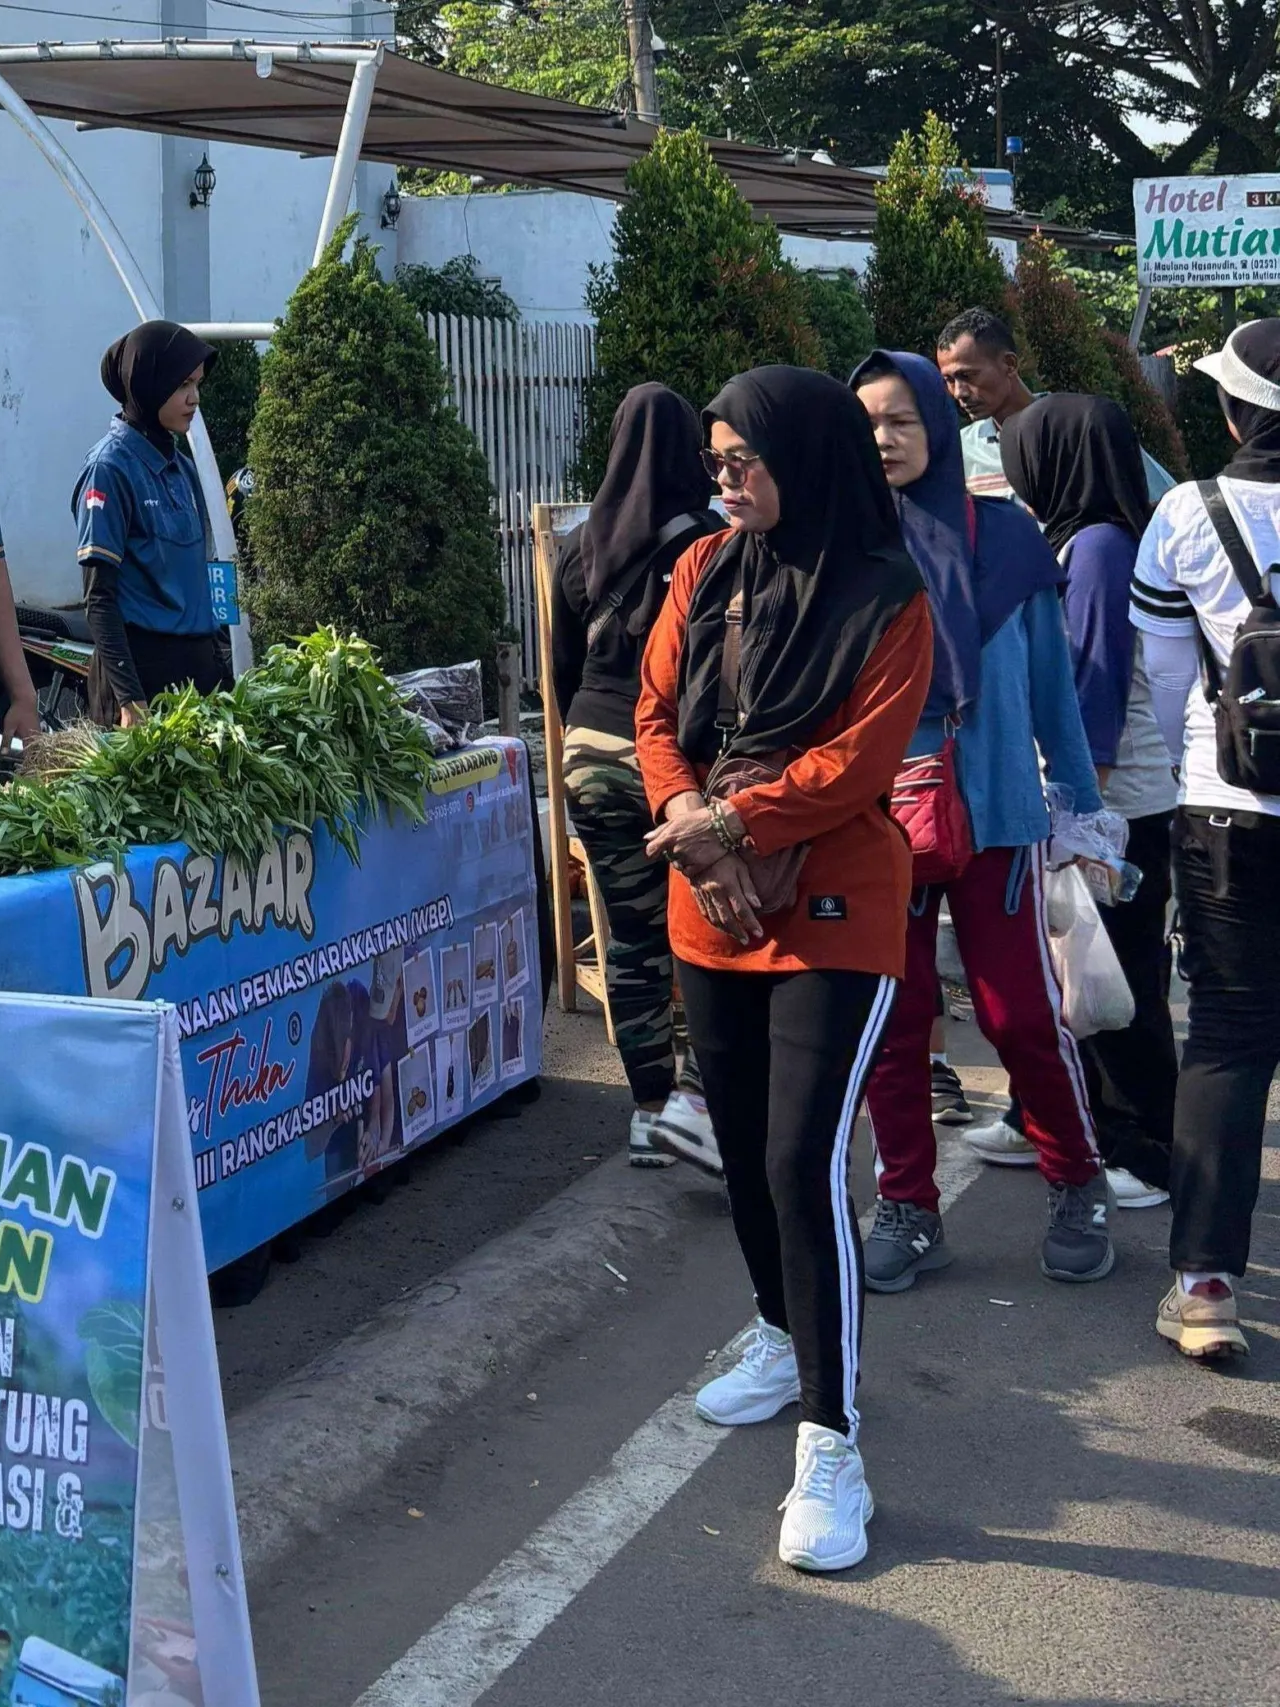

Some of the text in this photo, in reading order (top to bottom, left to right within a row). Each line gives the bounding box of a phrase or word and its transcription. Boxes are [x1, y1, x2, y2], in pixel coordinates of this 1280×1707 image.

[1145, 180, 1228, 214] Hotel
[1251, 193, 1280, 206] 3 K
[1149, 272, 1185, 283] (Samping
[1187, 271, 1231, 282] Perumahan
[1232, 271, 1250, 280] Kota
[1154, 261, 1189, 271] Maulana
[74, 832, 316, 1000] BAZAAR
[239, 913, 410, 1012] PEMASYARAKATAN
[410, 894, 454, 945] (WBP)
[221, 1067, 375, 1179] RANGKASBITUNG
[55, 1472, 84, 1539] &
